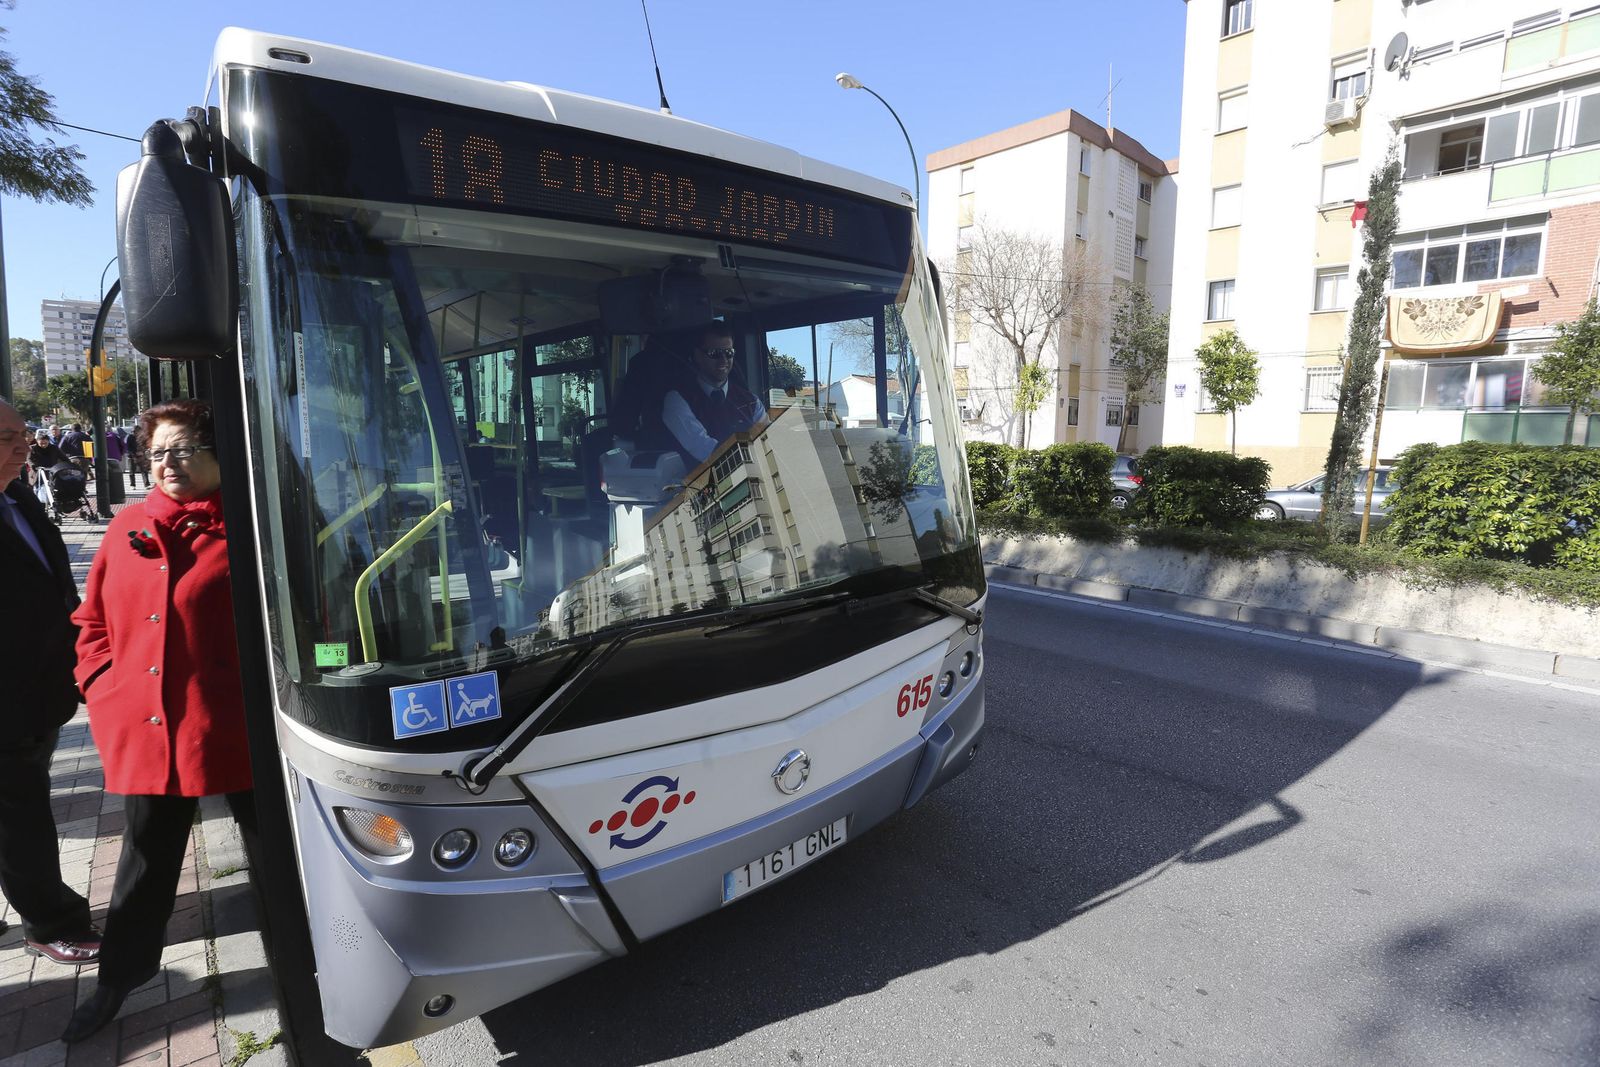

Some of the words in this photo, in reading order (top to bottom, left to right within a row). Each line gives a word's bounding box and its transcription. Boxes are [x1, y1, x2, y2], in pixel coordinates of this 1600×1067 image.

[420, 127, 505, 205] 1A
[539, 149, 697, 213] CIUDAD
[720, 186, 835, 238] JARDIN
[335, 649, 345, 657] 13
[896, 674, 934, 718] 615
[744, 841, 795, 888] 1161
[806, 823, 842, 857] GNL
